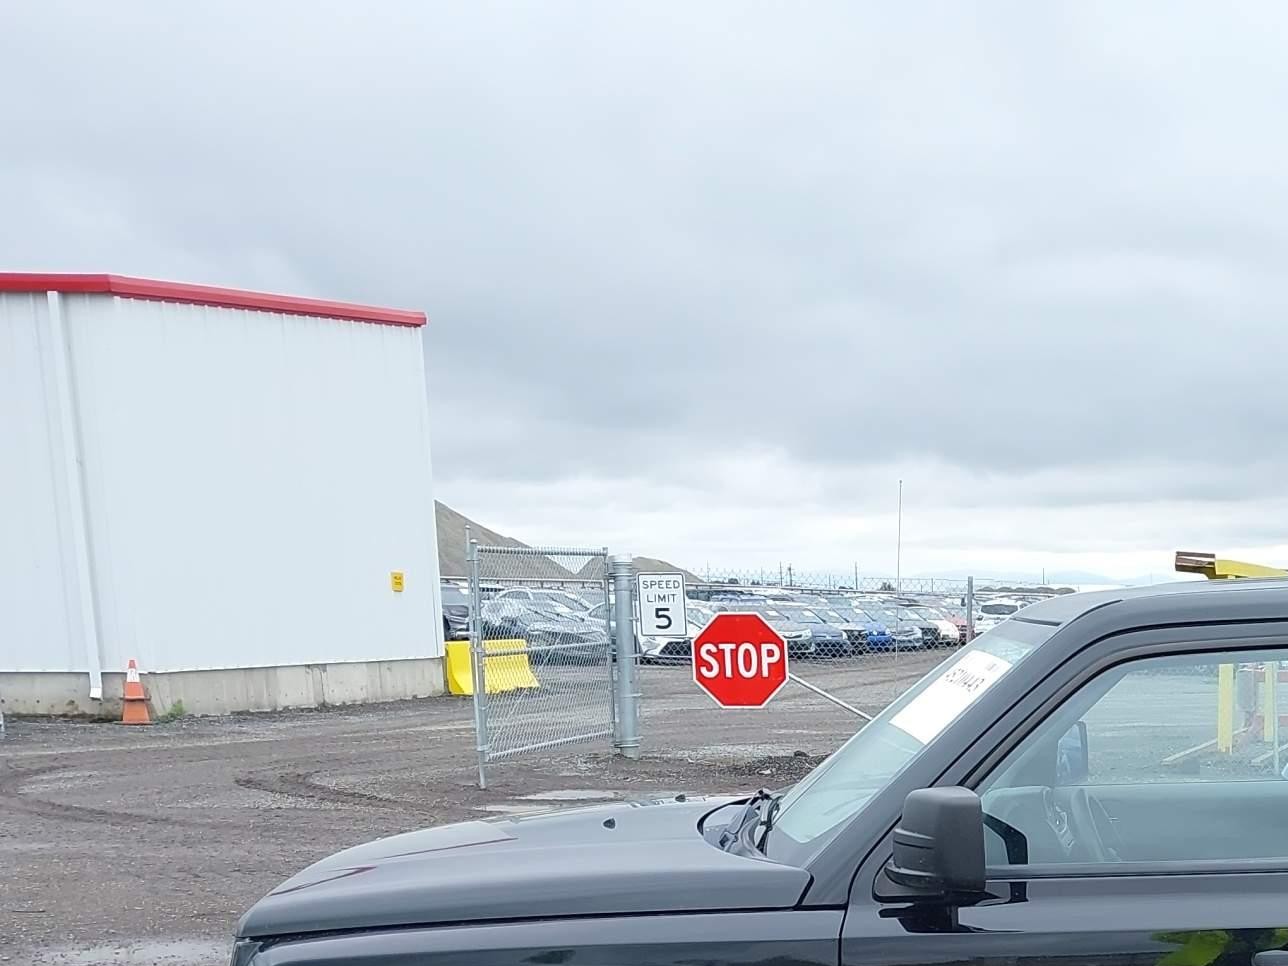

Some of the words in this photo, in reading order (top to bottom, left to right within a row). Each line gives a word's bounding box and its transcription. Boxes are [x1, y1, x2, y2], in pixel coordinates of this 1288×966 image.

[642, 579, 681, 590] SPEED
[646, 593, 677, 603] LIMIT
[654, 607, 673, 630] 5
[699, 642, 781, 679] STOP
